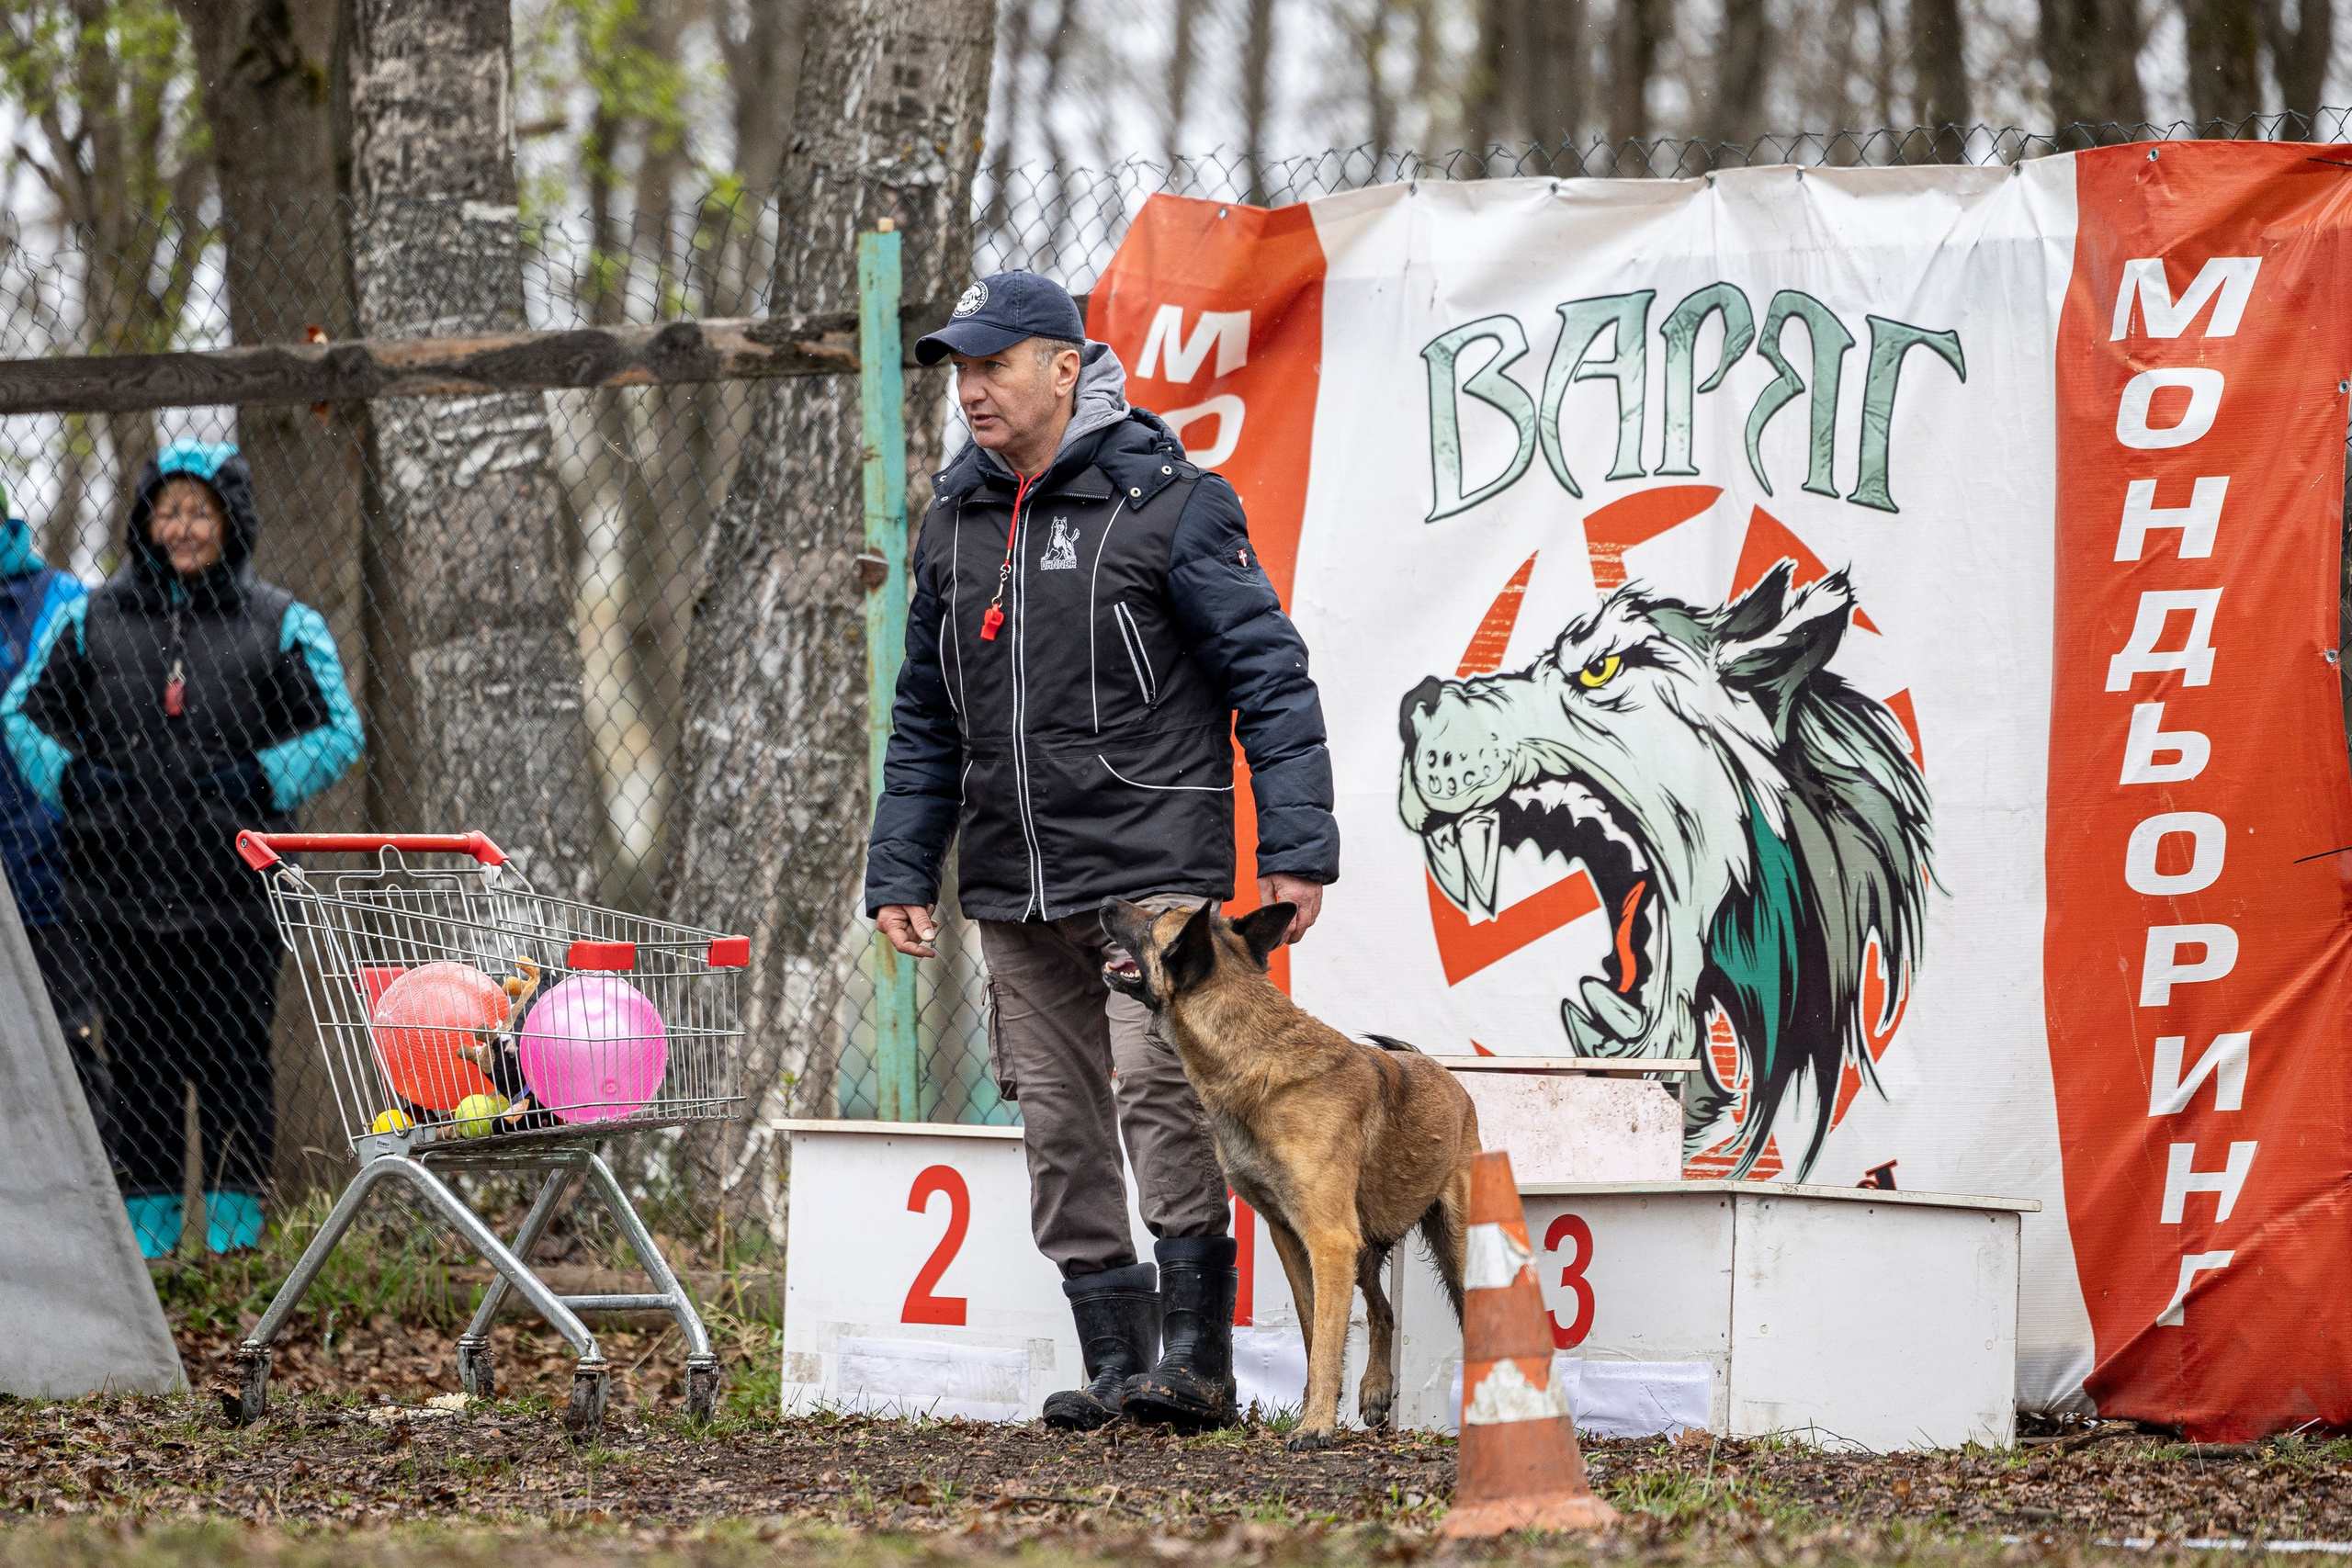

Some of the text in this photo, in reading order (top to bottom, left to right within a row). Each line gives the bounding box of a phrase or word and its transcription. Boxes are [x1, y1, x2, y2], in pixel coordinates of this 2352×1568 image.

[1419, 281, 1967, 524] ВАРЯГ
[2104, 256, 2263, 1327] МОНДЬОРИНГ
[900, 1165, 970, 1327] 2
[1544, 1213, 1595, 1350] 3
